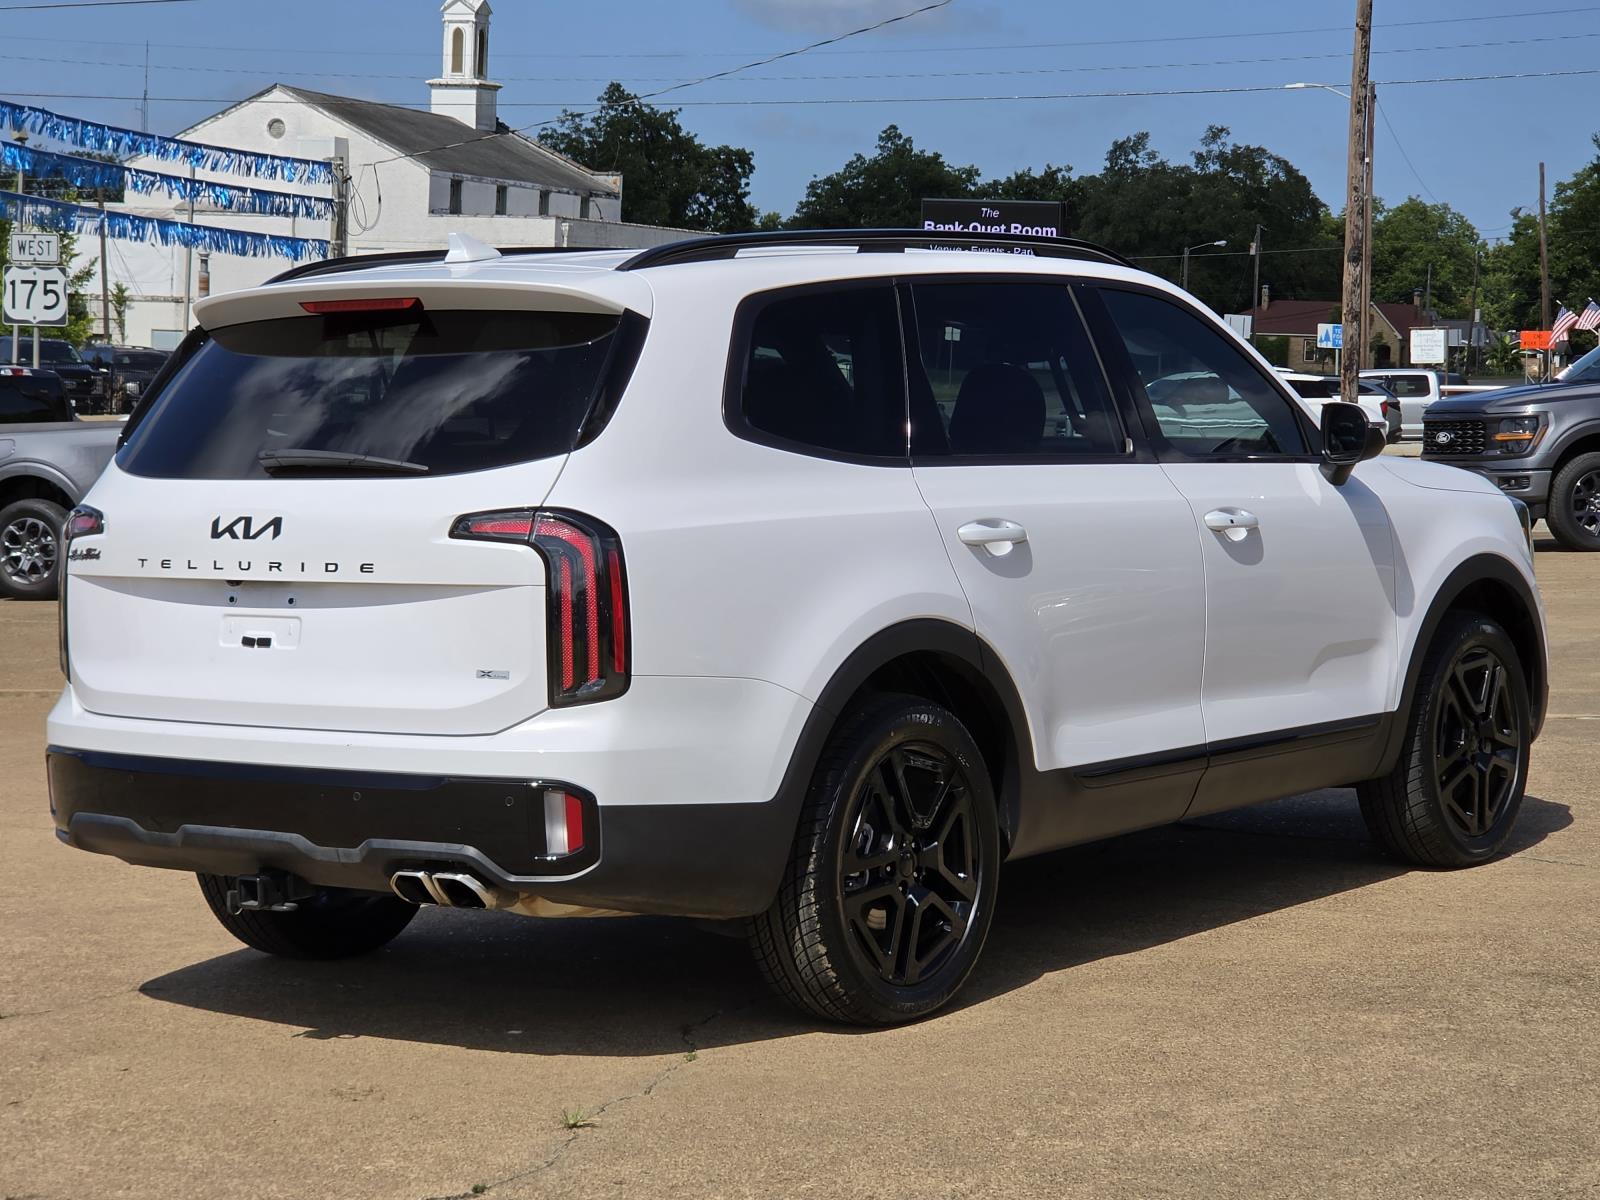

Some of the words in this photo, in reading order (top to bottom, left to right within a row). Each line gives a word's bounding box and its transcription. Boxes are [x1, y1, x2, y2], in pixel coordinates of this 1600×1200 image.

[981, 207, 1000, 218] The
[1010, 223, 1057, 237] Room
[17, 240, 52, 256] WEST
[9, 279, 60, 310] 175
[210, 516, 282, 539] KIA
[138, 558, 375, 573] TELLURIDE
